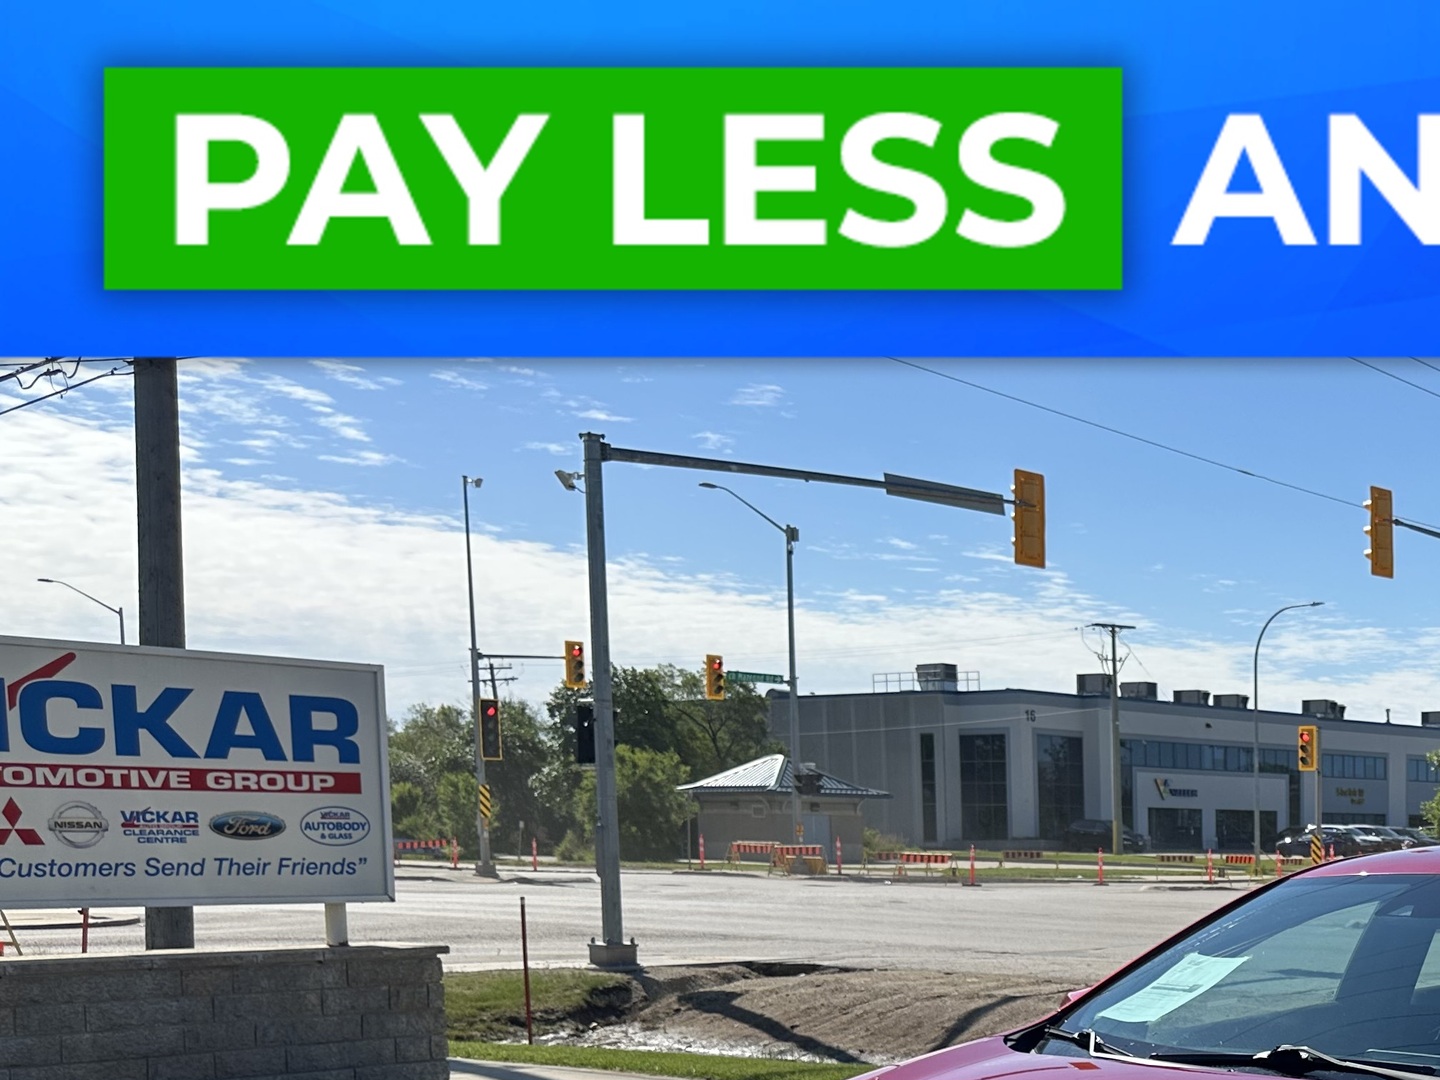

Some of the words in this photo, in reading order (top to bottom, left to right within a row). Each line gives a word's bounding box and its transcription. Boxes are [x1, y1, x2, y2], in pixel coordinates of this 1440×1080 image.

[0, 766, 192, 789] OMOTIVE
[205, 771, 336, 792] GROUP
[120, 809, 200, 824] VICKAR
[54, 820, 103, 830] NISSAN
[223, 815, 272, 836] Ford
[304, 821, 367, 832] AUTOBODY
[123, 828, 200, 837] CLEARANCE
[137, 836, 187, 844] CENTRE
[0, 857, 136, 878] Customers
[144, 857, 206, 877] Send
[213, 857, 271, 877] Their
